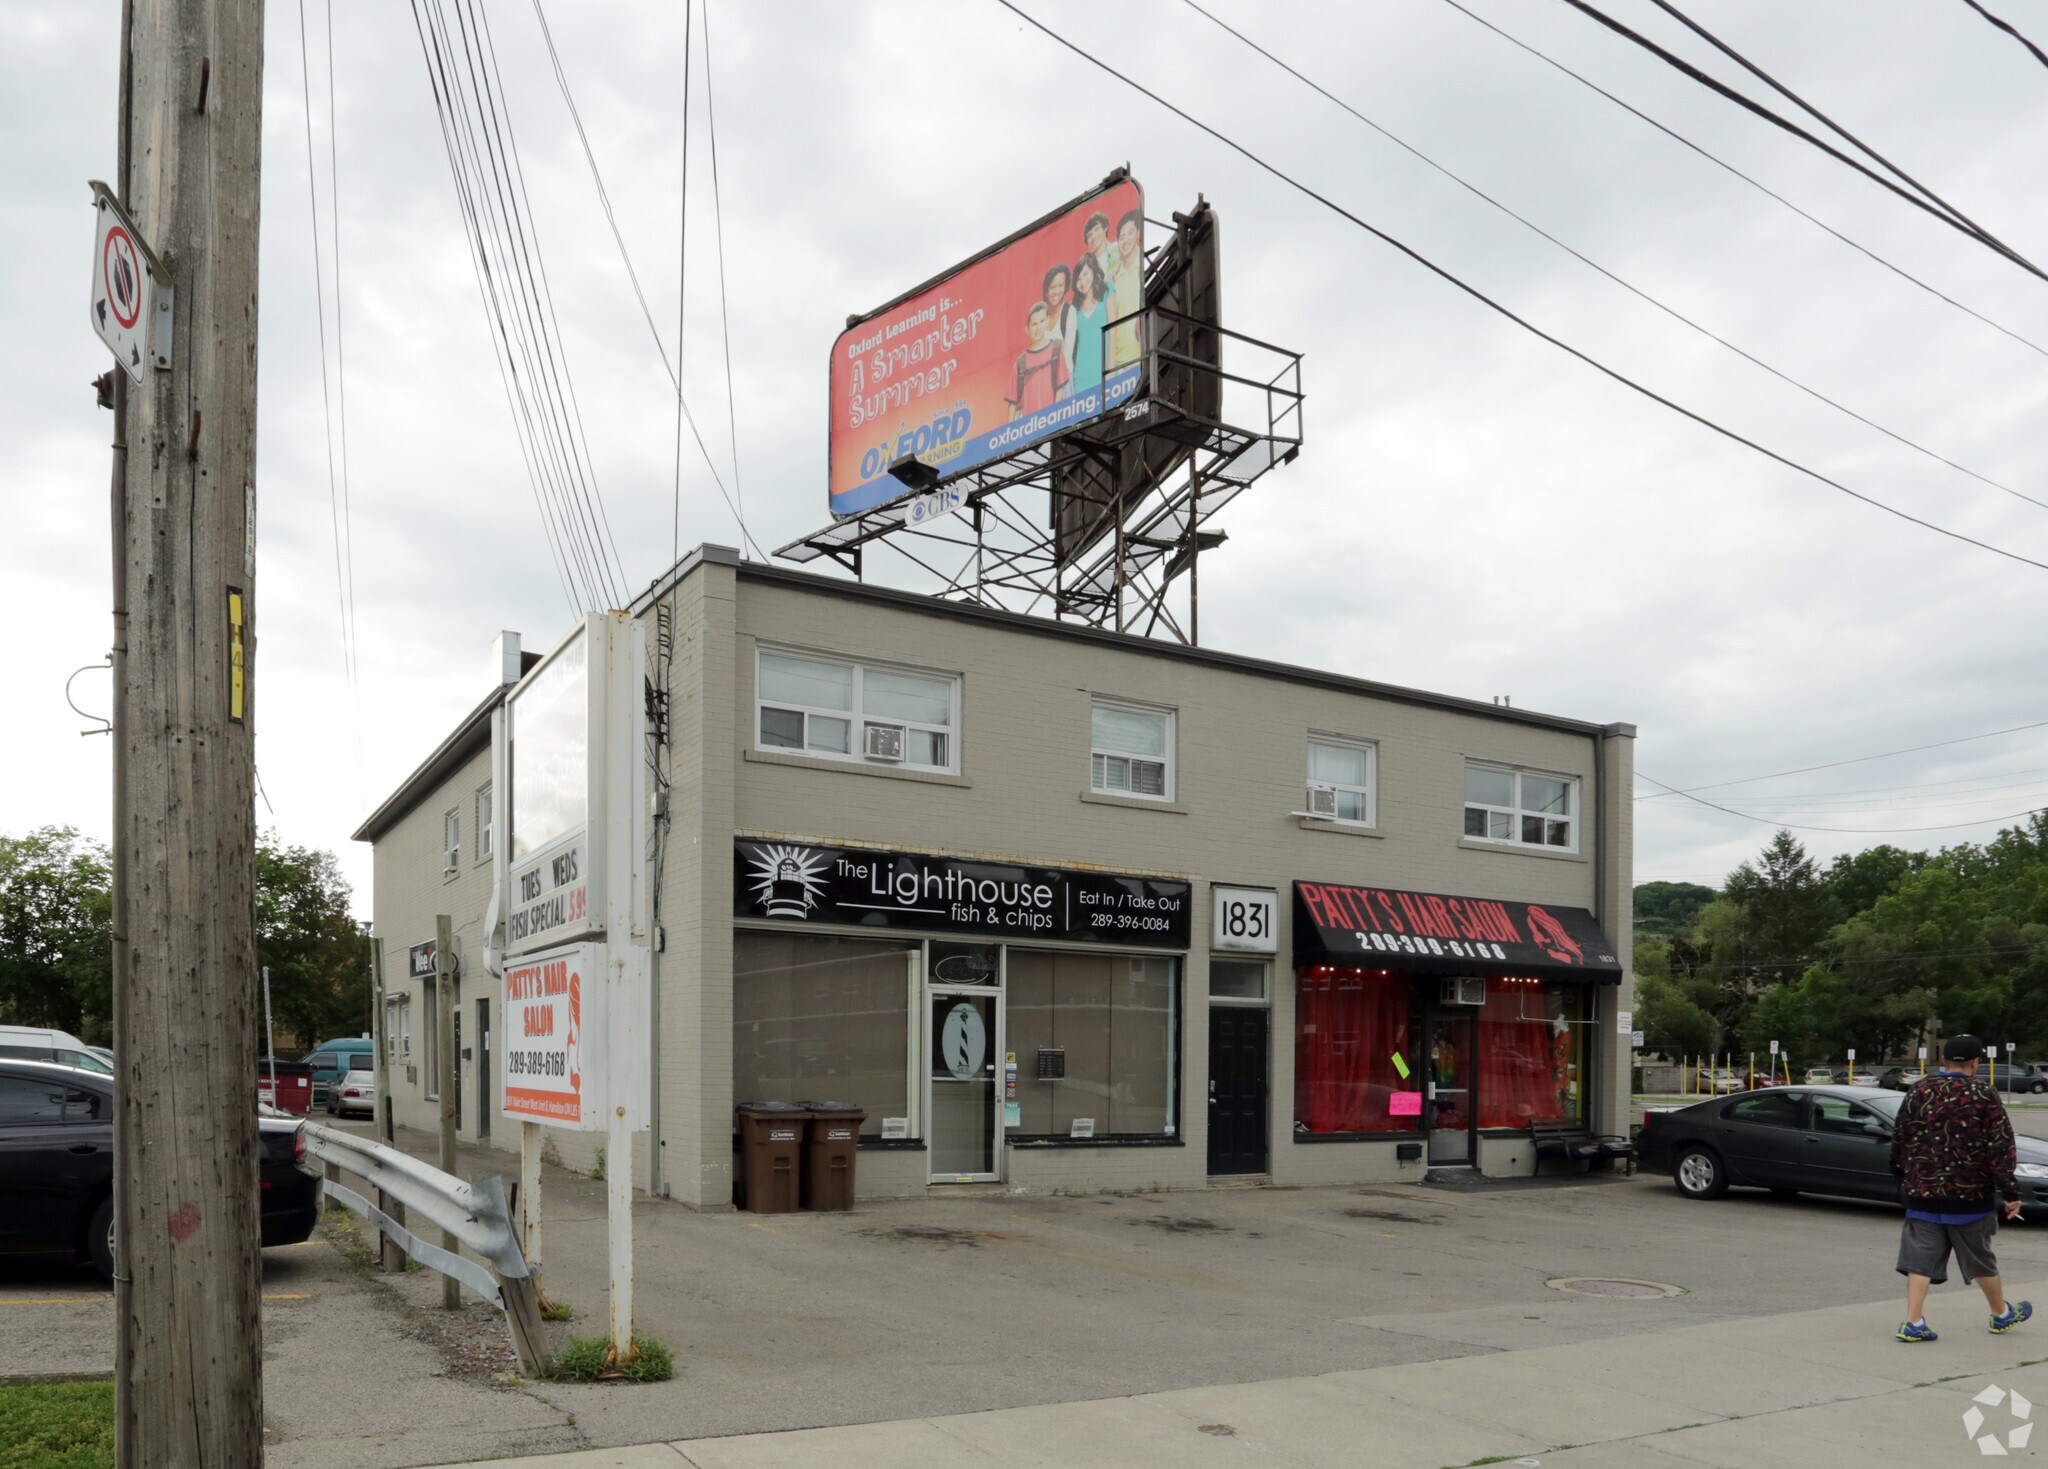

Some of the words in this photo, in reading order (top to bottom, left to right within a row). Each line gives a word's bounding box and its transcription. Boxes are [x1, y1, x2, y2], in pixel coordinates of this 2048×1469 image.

[848, 329, 883, 359] Oxford
[886, 305, 937, 340] Learning
[940, 297, 963, 312] is...
[848, 359, 864, 397] A
[871, 308, 985, 384] Smarter
[848, 358, 958, 429] Summer
[988, 375, 1137, 450] oxfordlearning.com
[1125, 401, 1150, 422] 2574
[860, 407, 972, 480] OXFORD
[928, 487, 960, 516] CBS
[521, 867, 542, 903] TUES
[552, 848, 578, 888] WEDS
[836, 858, 868, 880] The
[870, 862, 1054, 909] Lighthouse
[511, 909, 529, 942] FISH
[531, 894, 566, 935] SPECIAL
[950, 902, 980, 924] fish
[987, 905, 1000, 925] &
[1005, 906, 1054, 931] chips
[1079, 889, 1102, 906] Eat
[1102, 891, 1116, 907] In
[1126, 893, 1156, 910] Take
[1158, 896, 1181, 912] Out
[1222, 900, 1270, 939] 1831
[1300, 883, 1404, 933] PATTY'S
[1396, 893, 1462, 938] HAIR
[1090, 912, 1170, 932] 289-396-0084
[507, 965, 542, 1002] PATTY'S
[544, 959, 567, 997] HAIR
[524, 1003, 554, 1038] SALON
[508, 1051, 566, 1078] 289-389-6168
